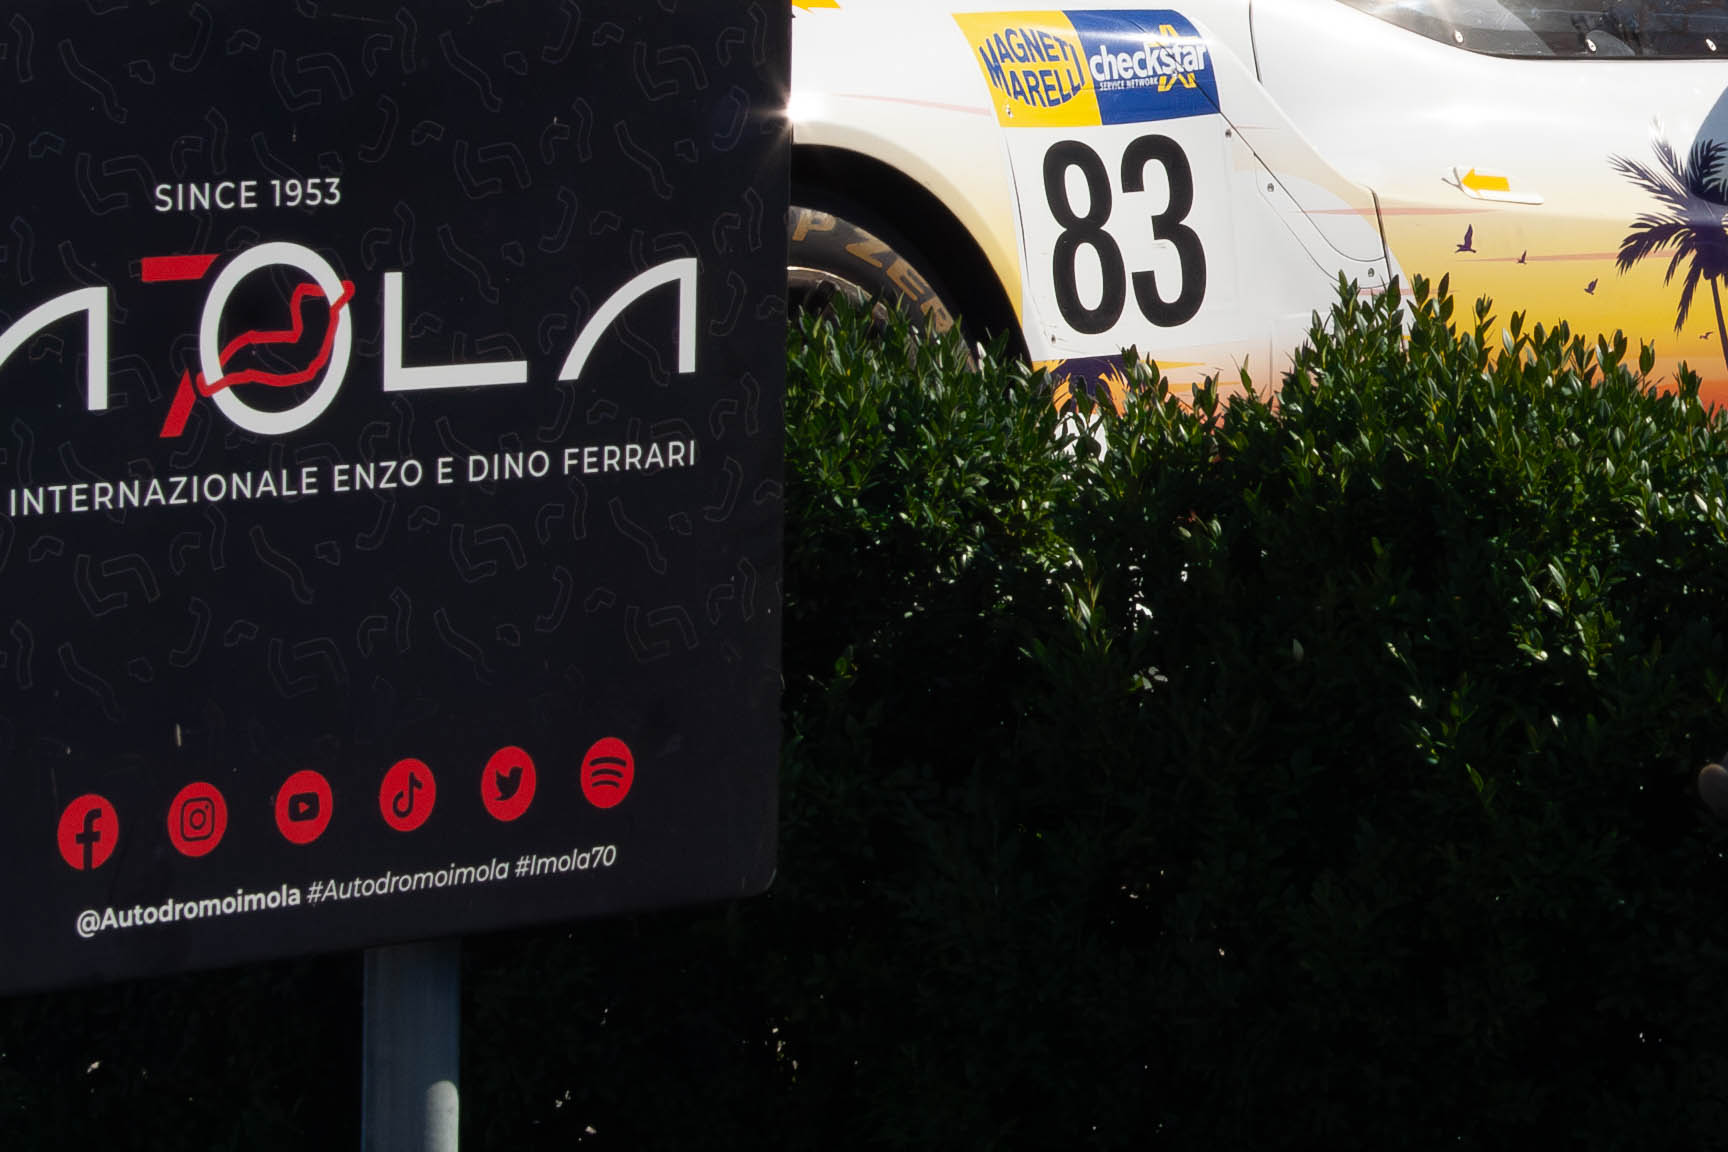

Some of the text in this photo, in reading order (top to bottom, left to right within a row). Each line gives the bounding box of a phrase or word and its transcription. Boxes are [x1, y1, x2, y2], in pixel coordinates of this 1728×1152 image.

[1090, 41, 1207, 82] checkstar
[1100, 76, 1159, 92] SERVICE NETWORK
[155, 177, 341, 212] SINCE 1953
[1043, 134, 1207, 335] 83
[10, 439, 696, 517] INTERNAZIONALE ENZO E DINO FERRARI
[77, 844, 617, 939] @Autodromoimola #Autodromoimola #Imola70
